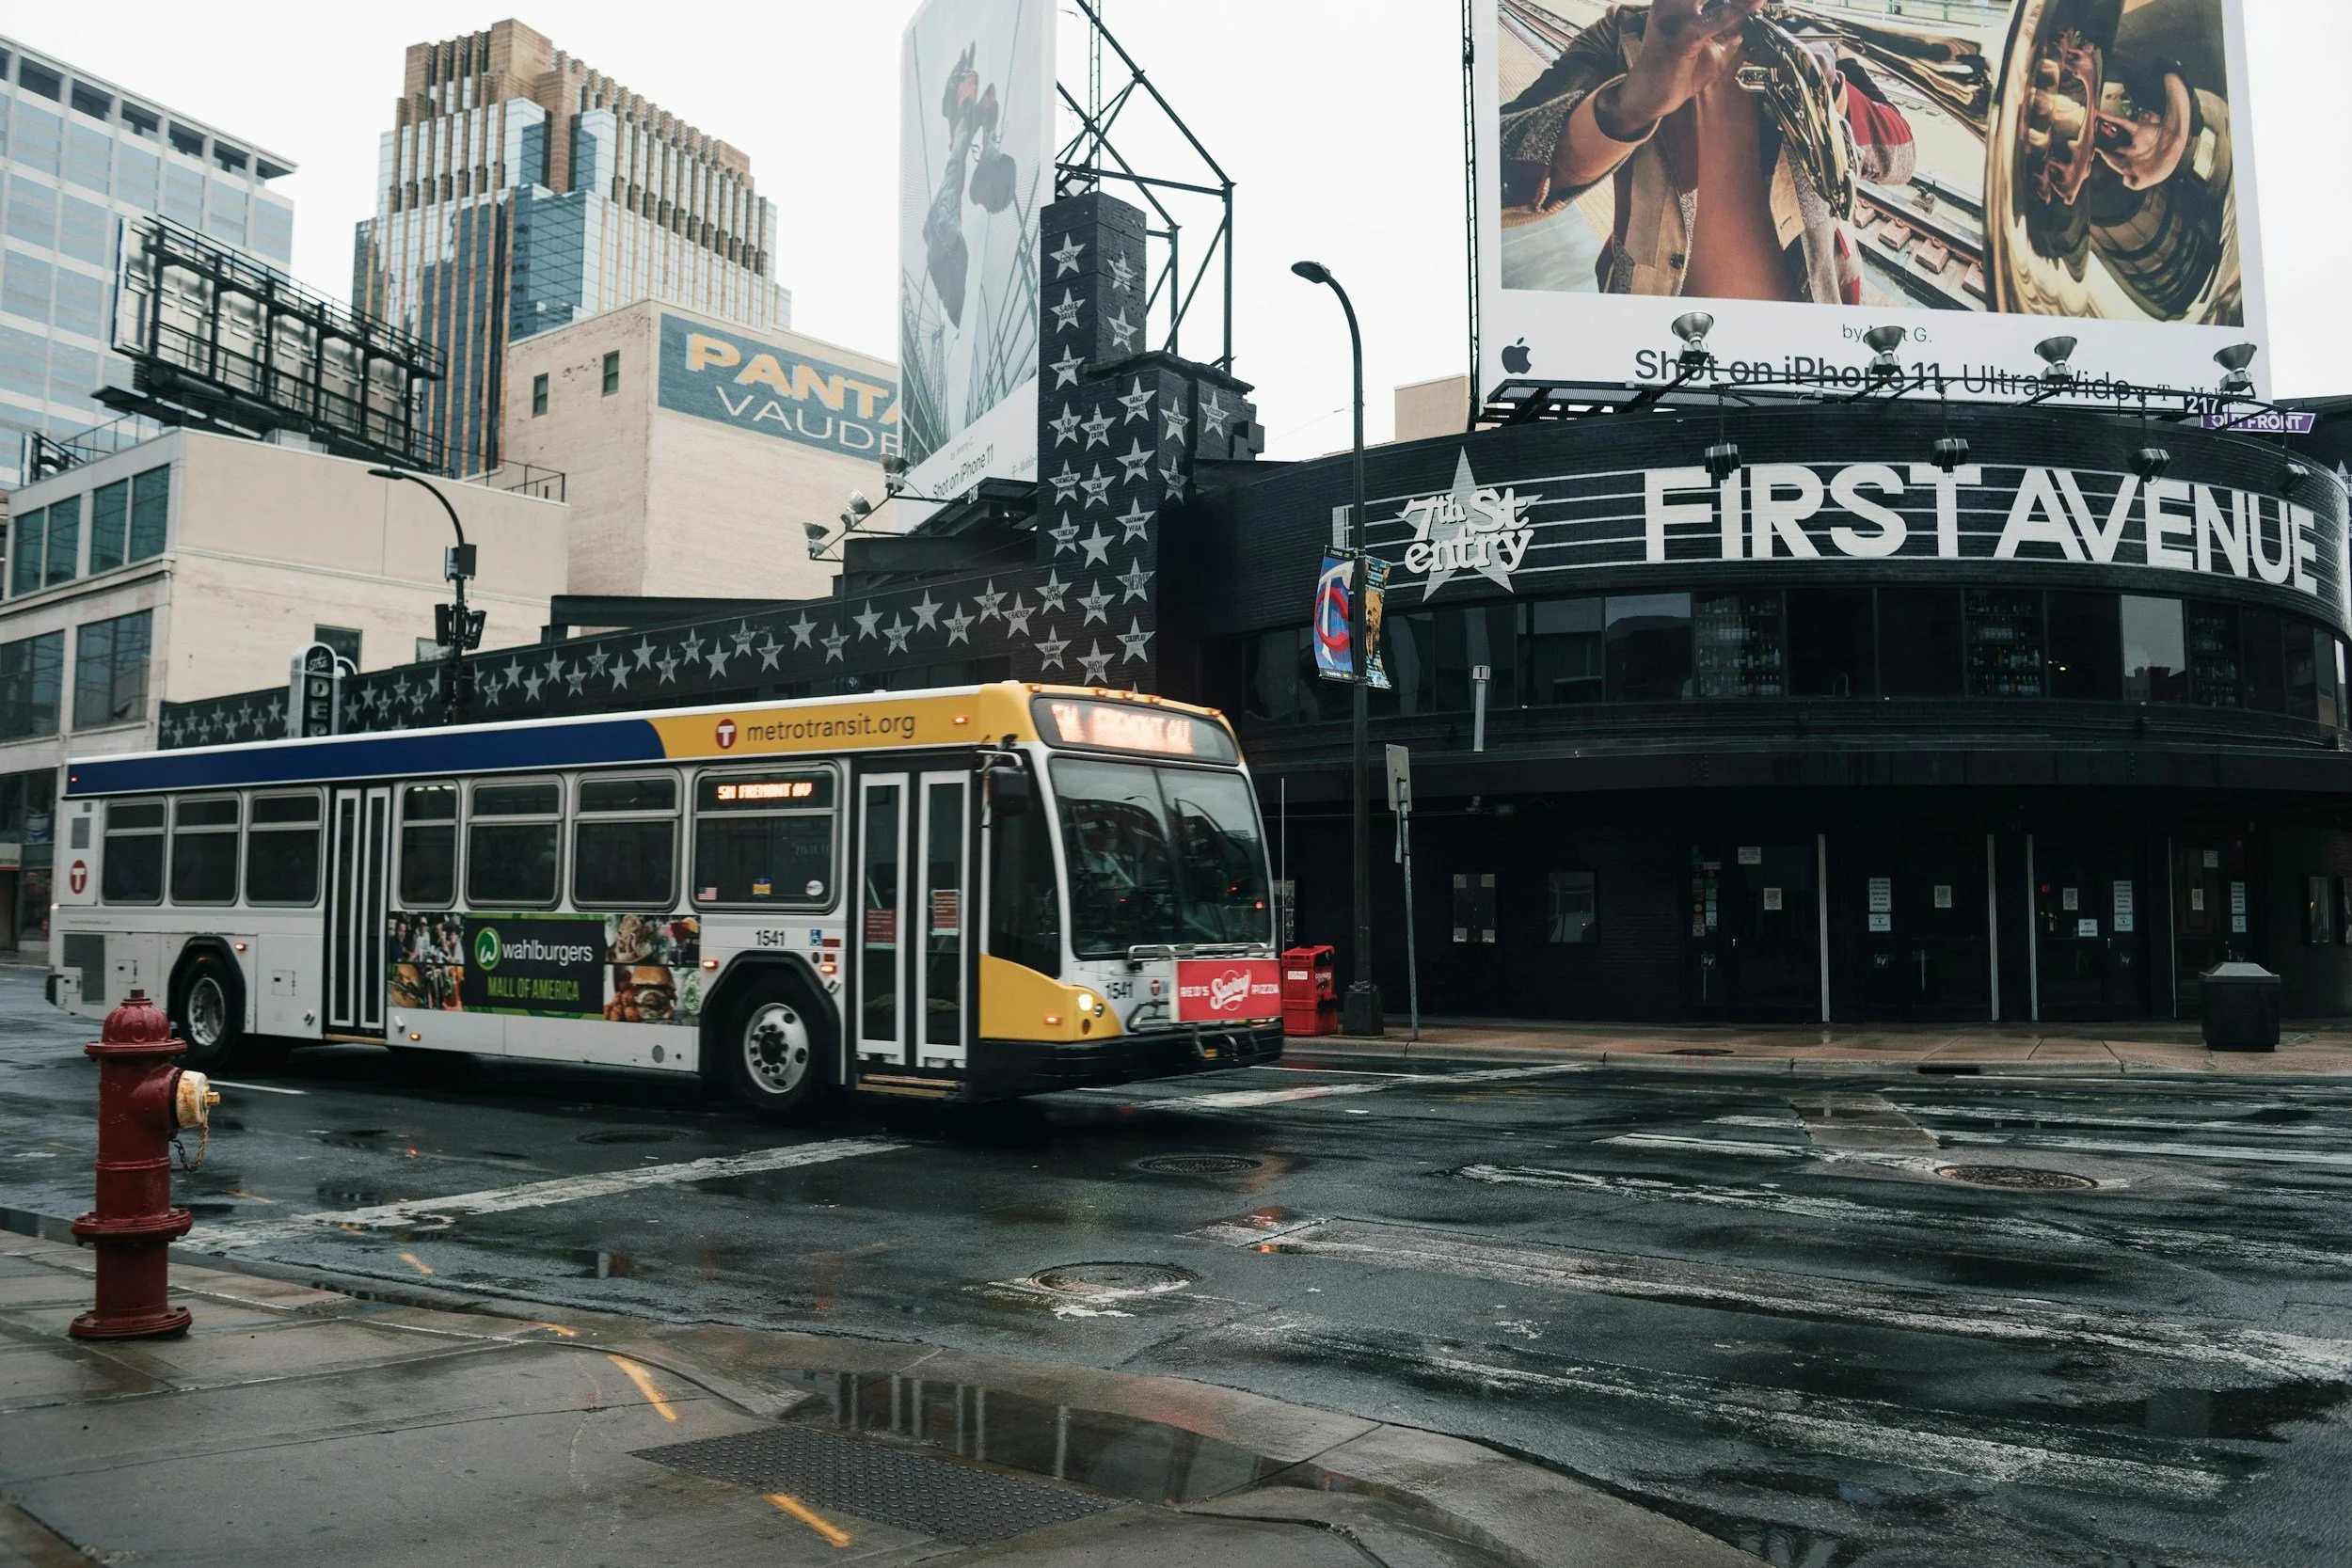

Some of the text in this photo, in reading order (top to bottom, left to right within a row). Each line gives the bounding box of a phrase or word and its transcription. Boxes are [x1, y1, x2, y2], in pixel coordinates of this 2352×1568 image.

[1842, 324, 1862, 343] by
[1729, 361, 1772, 384] on
[1911, 361, 1941, 392] 11
[1963, 364, 2040, 395] Ultra
[2186, 395, 2218, 414] 217
[950, 473, 959, 490] on
[960, 453, 985, 483] iPhone
[986, 443, 993, 465] 11
[1401, 487, 1531, 542] 7th St
[1128, 524, 1142, 532] VEGA
[1645, 464, 2317, 596] FIRST AVENUE
[1405, 525, 1534, 574] entry
[1090, 596, 1100, 605] LIZ
[1009, 610, 1030, 620] CRACKER
[1124, 633, 1147, 643] COLDPLAY
[746, 713, 916, 740] metrotransit.org
[739, 783, 792, 799] FREMONT
[755, 929, 785, 946] 1541
[501, 939, 594, 966] wahlburgers
[487, 976, 580, 1001] MALL OF AMERICA
[1180, 986, 1210, 998] RED'S
[1251, 984, 1280, 995] PIZZA
